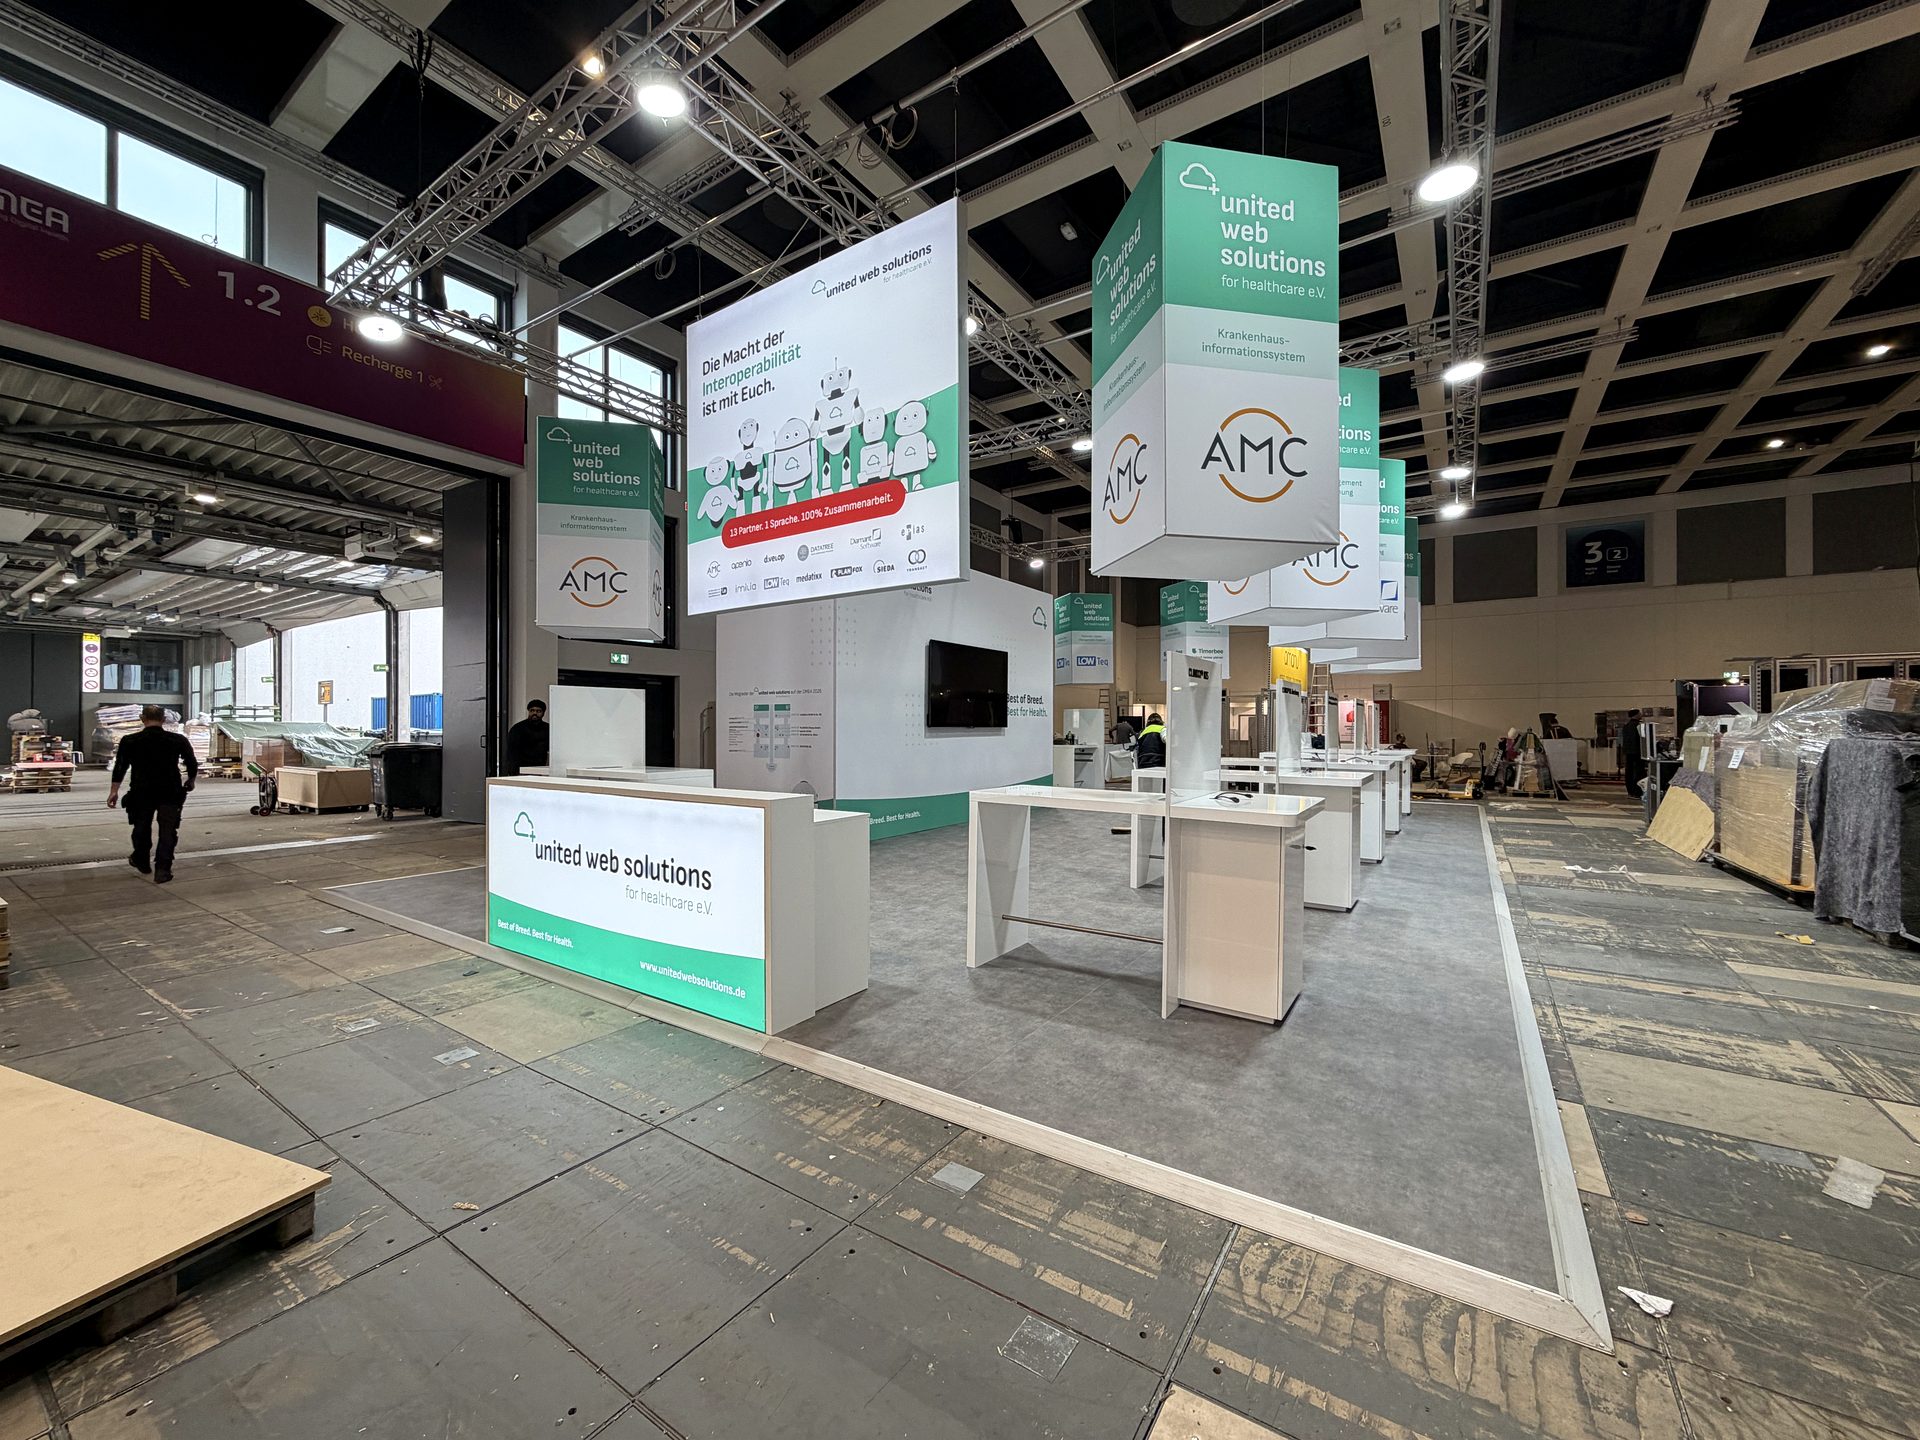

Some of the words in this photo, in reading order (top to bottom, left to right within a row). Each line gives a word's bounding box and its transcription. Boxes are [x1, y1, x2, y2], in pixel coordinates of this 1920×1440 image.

[1221, 193, 1295, 222] united
[1221, 221, 1268, 244] web
[1110, 218, 1141, 281] united
[1221, 246, 1326, 277] solutions
[826, 275, 857, 298] united
[859, 266, 880, 283] web
[882, 244, 932, 274] solutions
[883, 275, 892, 283] for
[892, 262, 922, 281] healthcare
[1110, 265, 1129, 302] web
[217, 270, 282, 317] 1.2
[1110, 253, 1156, 326] solutions
[1221, 274, 1239, 288] for
[1242, 277, 1305, 297] healthcare
[1308, 286, 1326, 299] e.V.
[1110, 331, 1118, 345] for
[1117, 295, 1146, 336] healthcare
[1217, 328, 1290, 345] Krankenhaus-
[341, 346, 413, 380] Recharge
[416, 371, 424, 383] 1
[702, 357, 720, 376] Die
[723, 339, 761, 367] Macht
[763, 330, 785, 349] der
[1201, 342, 1306, 363] informationssystem
[702, 344, 801, 396] Interoperabilität
[1108, 355, 1139, 393] Krankenhaus-
[702, 400, 717, 417] ist
[719, 391, 738, 410] mit
[741, 378, 775, 402] Euch.
[1103, 360, 1147, 411] informationssystem
[573, 442, 620, 456] united
[573, 457, 603, 469] web
[1200, 432, 1308, 478] AMC
[1359, 447, 1371, 455] e.V.
[573, 470, 641, 486] solutions
[586, 487, 627, 497] healthcare
[1103, 444, 1148, 511] AMC
[560, 523, 627, 532] informationssystem
[571, 514, 617, 523] Krankenhaus-
[730, 528, 738, 538] 13
[738, 522, 764, 535] Partner.
[765, 520, 770, 529] 1
[770, 514, 800, 531] Sprache.
[800, 509, 823, 522] 100%
[824, 493, 893, 517] Zusammenarbeit.
[1584, 541, 1603, 564] 3
[1613, 549, 1621, 559] 2
[559, 570, 628, 594] AMC
[707, 564, 721, 575] AMC
[796, 571, 822, 583] medatixx
[877, 564, 895, 573] SIEDA
[1019, 706, 1029, 717] for
[1029, 707, 1047, 717] Health.
[1020, 694, 1026, 703] of
[1026, 694, 1044, 705] Breed.
[535, 840, 582, 867] united
[586, 848, 619, 874] web
[623, 854, 712, 890] solutions
[625, 884, 639, 900] for
[641, 887, 694, 912] healthcare
[696, 900, 713, 916] e.V.
[497, 918, 509, 930] Best
[509, 923, 515, 931] of
[515, 925, 531, 937] Breed.
[532, 928, 544, 940] Best
[545, 932, 553, 942] for
[553, 935, 574, 949] Health.
[640, 960, 746, 999] www.unitedwebsolutions.de
